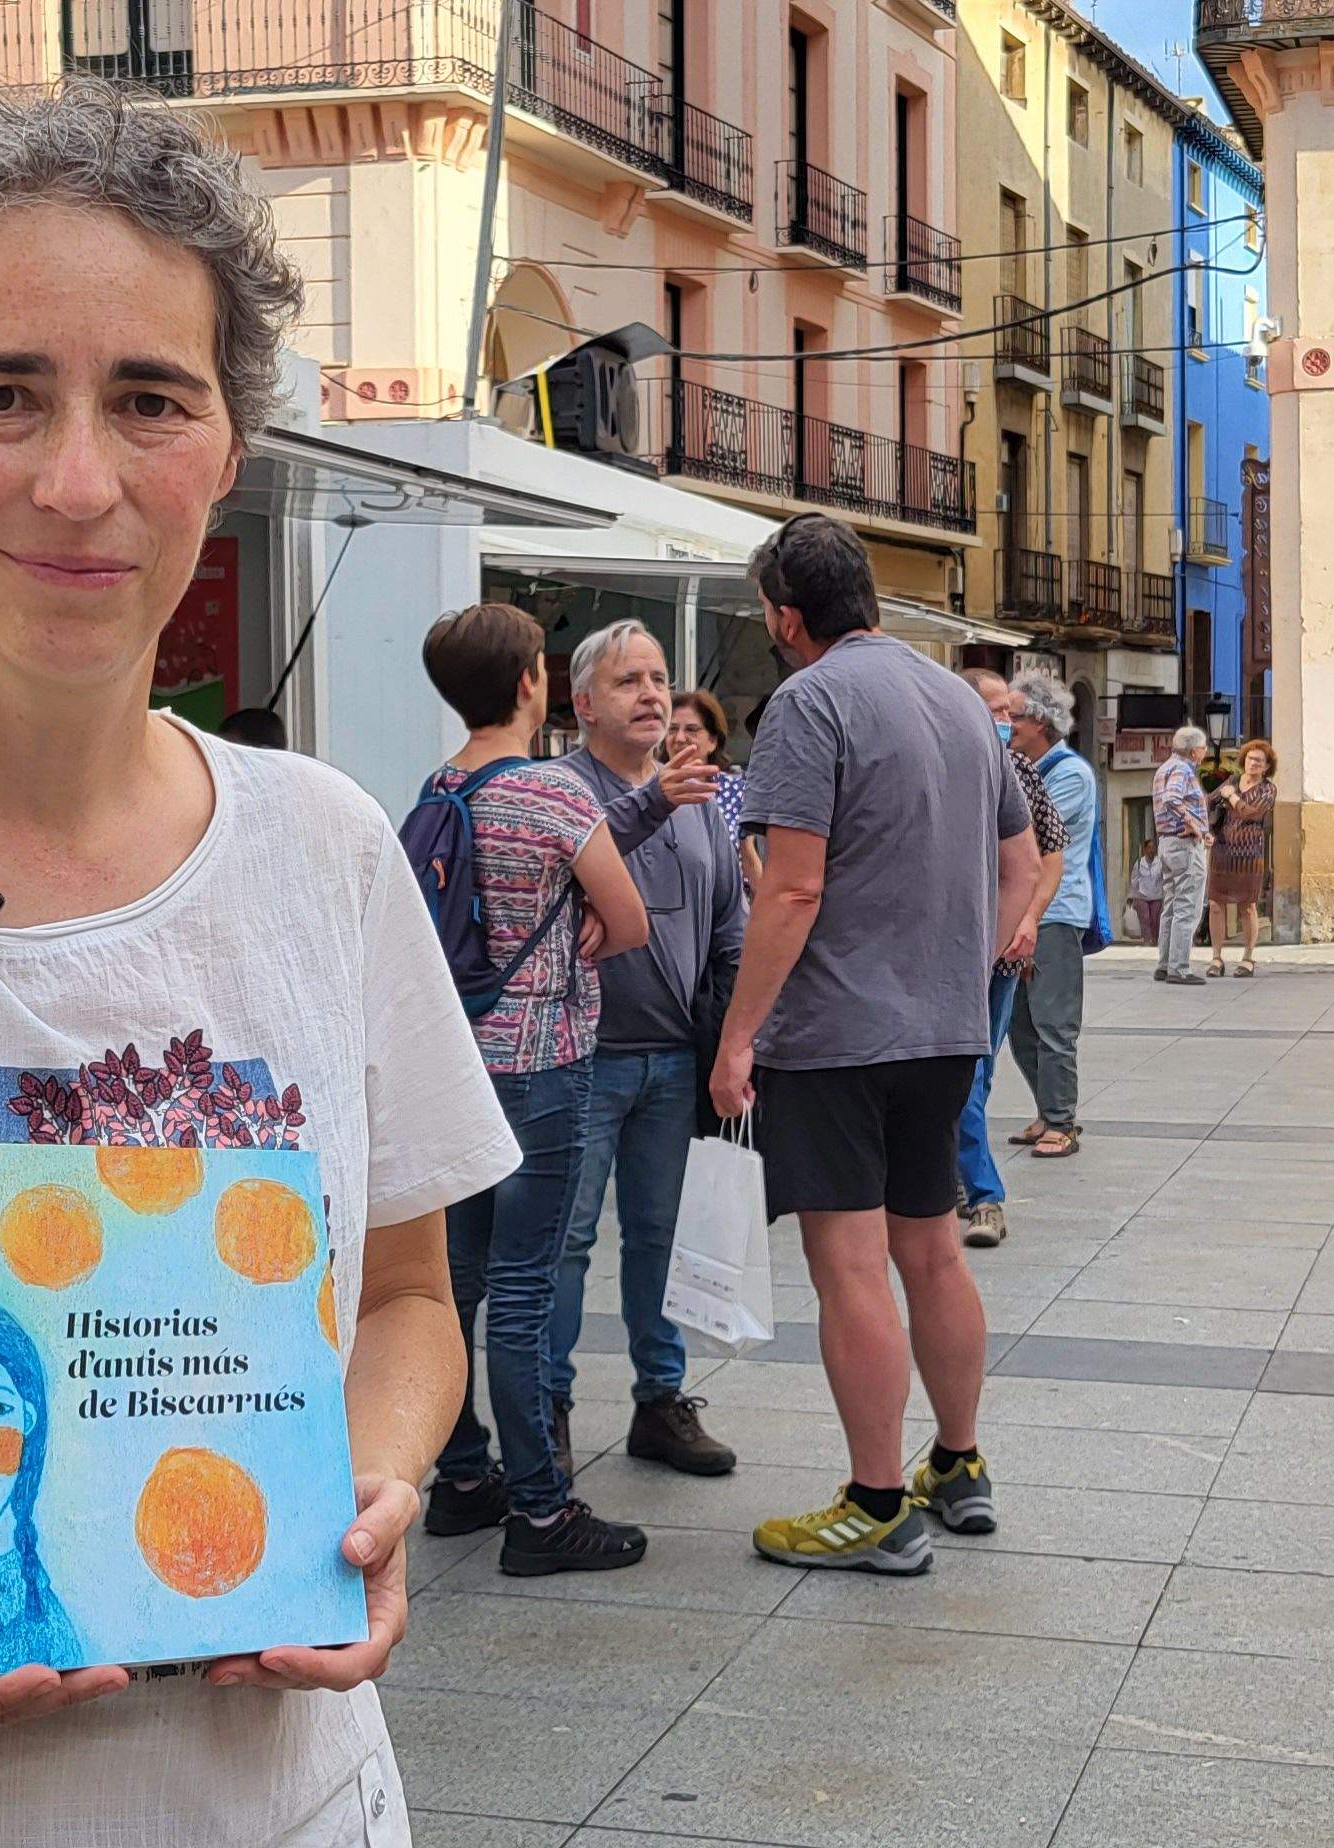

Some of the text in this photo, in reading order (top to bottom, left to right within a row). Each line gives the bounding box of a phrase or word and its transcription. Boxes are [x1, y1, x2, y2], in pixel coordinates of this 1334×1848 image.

[65, 1308, 218, 1338] Historias
[68, 1347, 249, 1379] d'antis más
[78, 1384, 306, 1419] de Biscarrués
